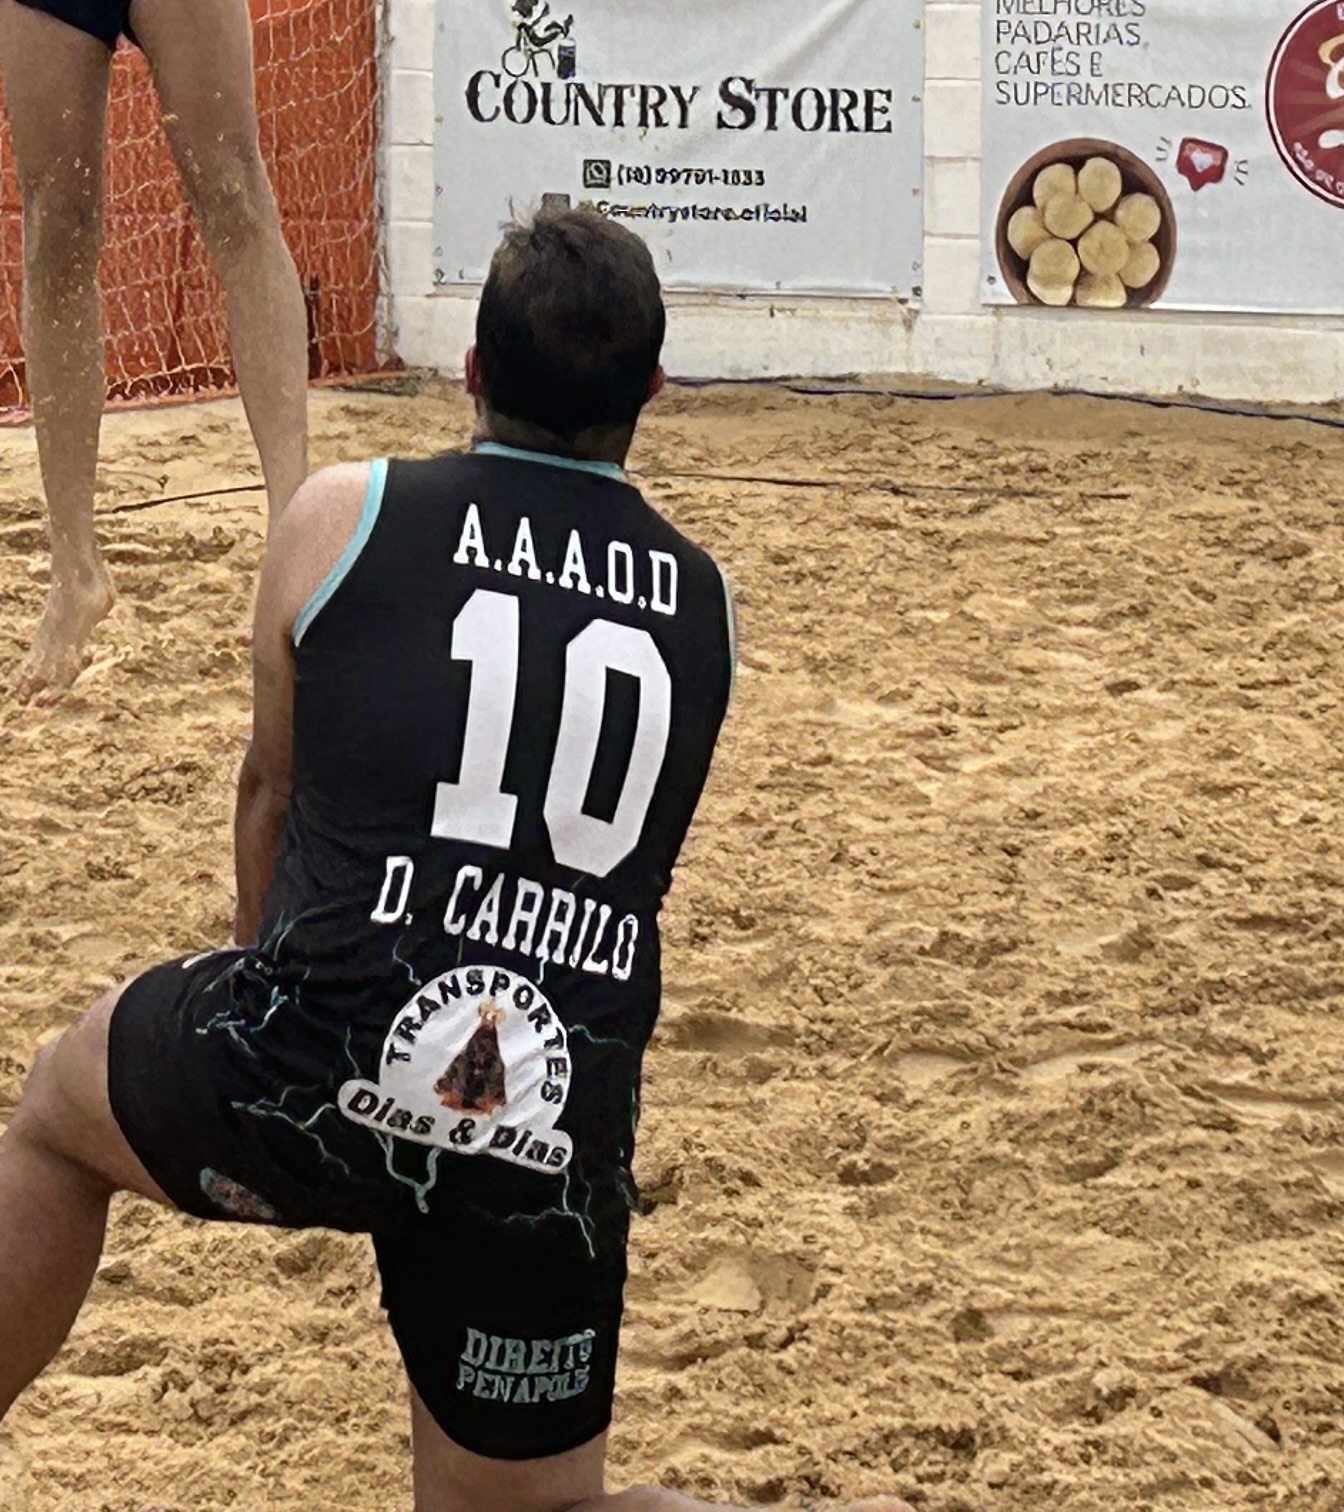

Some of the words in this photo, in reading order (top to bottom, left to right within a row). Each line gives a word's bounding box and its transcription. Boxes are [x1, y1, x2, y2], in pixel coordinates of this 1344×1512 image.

[465, 69, 700, 129] COUNTRY
[716, 76, 894, 133] STORE
[994, 46, 1081, 77] CAFÉS
[1090, 51, 1104, 77] E
[995, 80, 1253, 110] SUPERMERCADOS.
[452, 502, 679, 615] A.A.A.O.D
[430, 588, 672, 878] 10
[370, 855, 415, 926] D.
[443, 864, 639, 981] CARRILO
[386, 968, 568, 1105] TRANSPORTES
[449, 1118, 476, 1146] &
